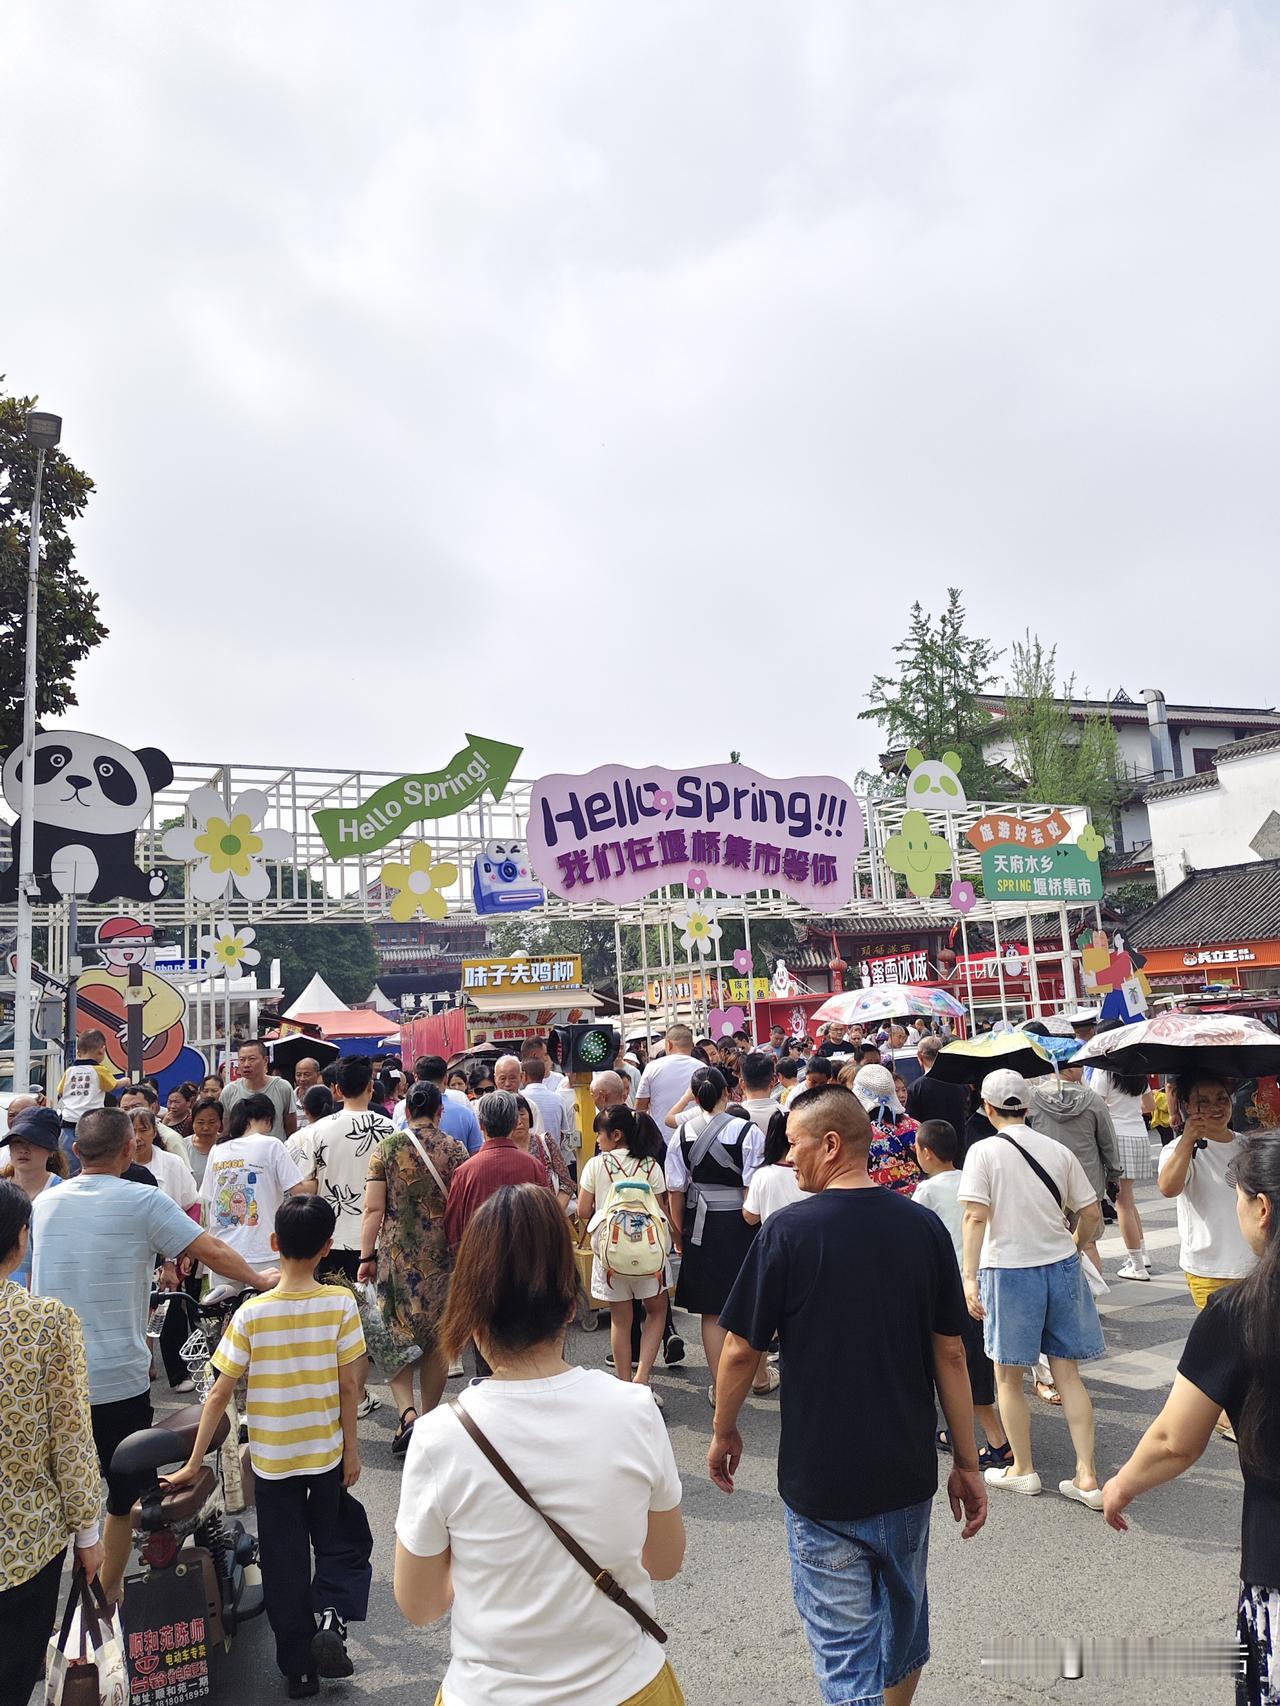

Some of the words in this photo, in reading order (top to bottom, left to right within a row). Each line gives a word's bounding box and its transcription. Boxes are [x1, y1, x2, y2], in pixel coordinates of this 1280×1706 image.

[338, 800, 402, 842] Hello
[403, 751, 492, 807] Spring!
[556, 829, 839, 889] 我们在堰桥集市等你
[993, 854, 1054, 874] 天府水乡
[997, 879, 1032, 893] SPRING
[1033, 877, 1092, 897] 堰桥集市
[464, 961, 574, 988] 味子夫鸡柳
[871, 952, 928, 985] 蜜雪冰城
[128, 1617, 205, 1659] 顺和苑陈师
